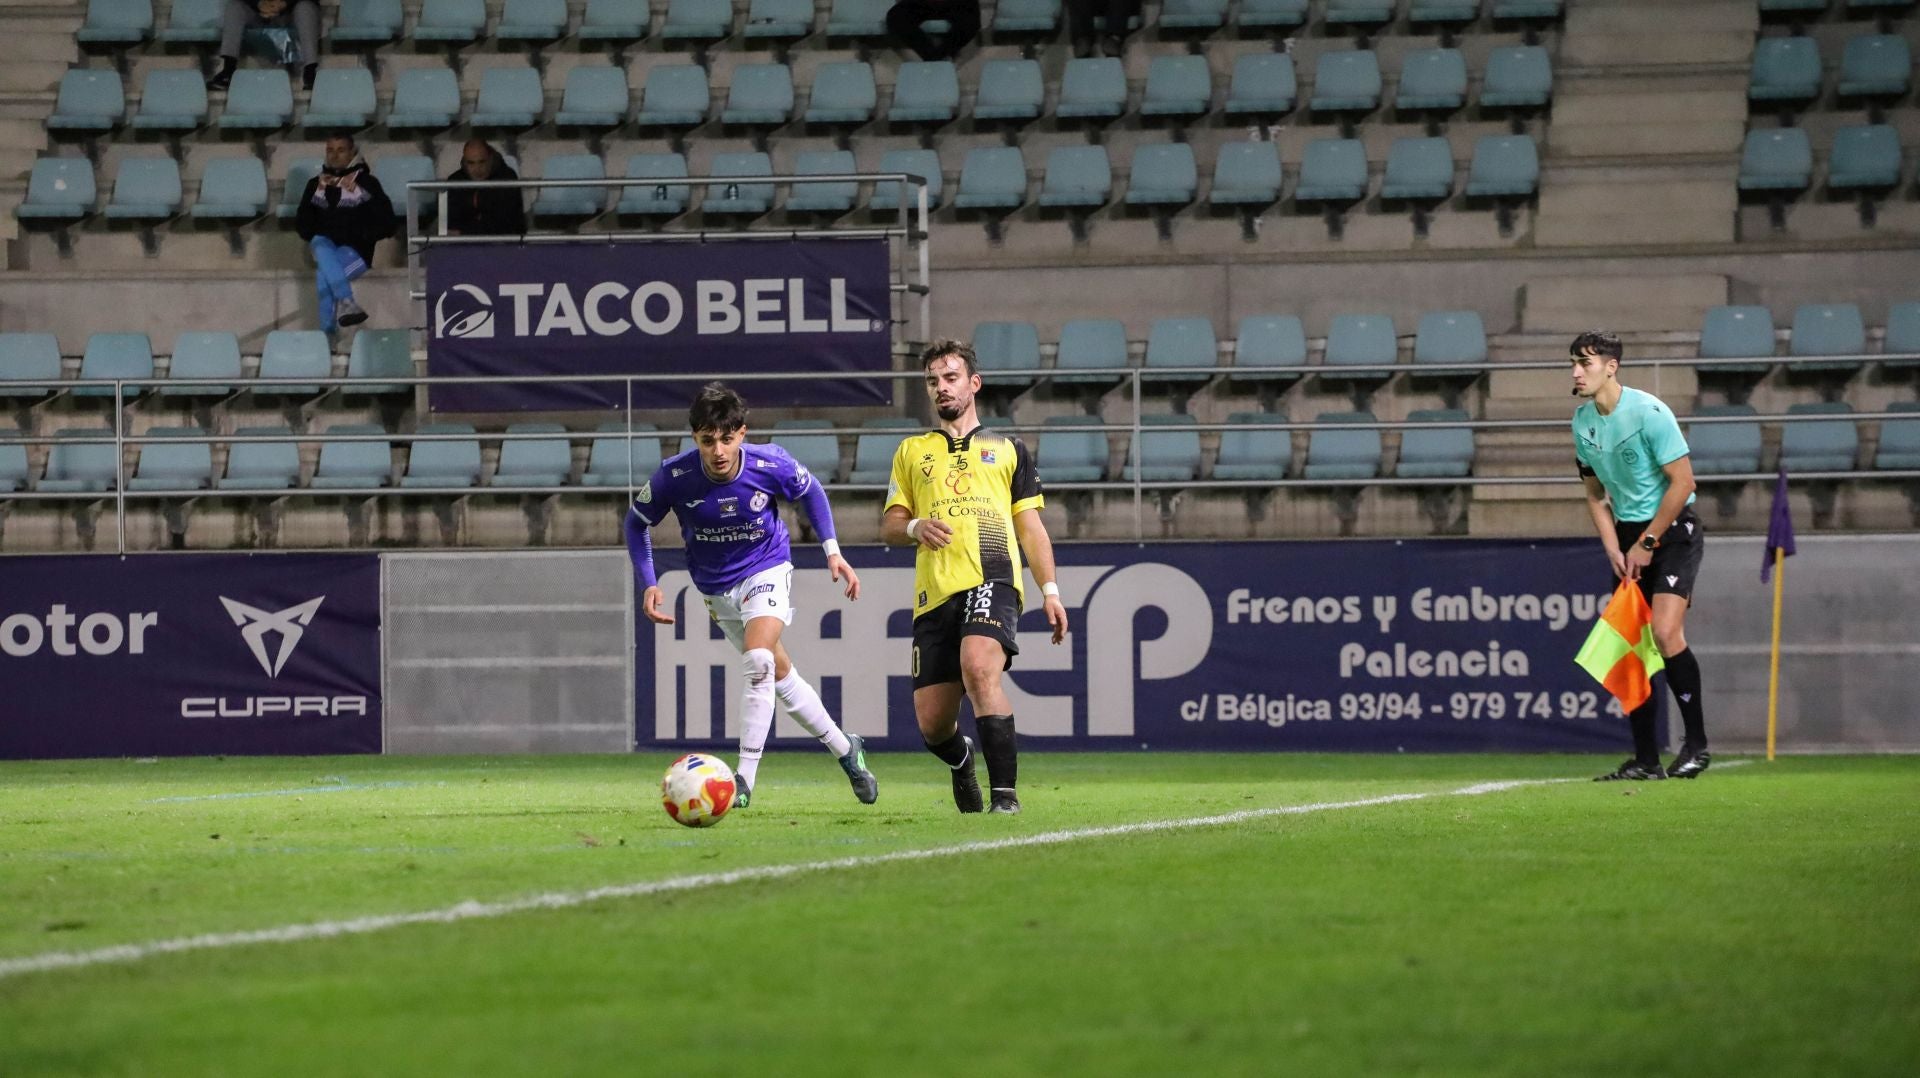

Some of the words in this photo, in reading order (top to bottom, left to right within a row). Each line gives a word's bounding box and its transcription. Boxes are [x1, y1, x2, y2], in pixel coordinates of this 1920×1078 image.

[499, 281, 683, 336] TACO
[697, 278, 870, 334] BELL
[931, 496, 991, 508] RESTAURANTE
[972, 617, 1003, 628] KELME
[1228, 589, 1362, 624] Frenos
[1374, 596, 1397, 632] y
[0, 604, 158, 657] otor
[1340, 641, 1529, 677] Palencia
[181, 696, 367, 718] CUPRA
[1217, 693, 1331, 727] Bélgica
[1340, 693, 1422, 721] 93/94
[1450, 691, 1506, 719] 979
[1514, 691, 1553, 719] 74
[1560, 691, 1598, 719] 92
